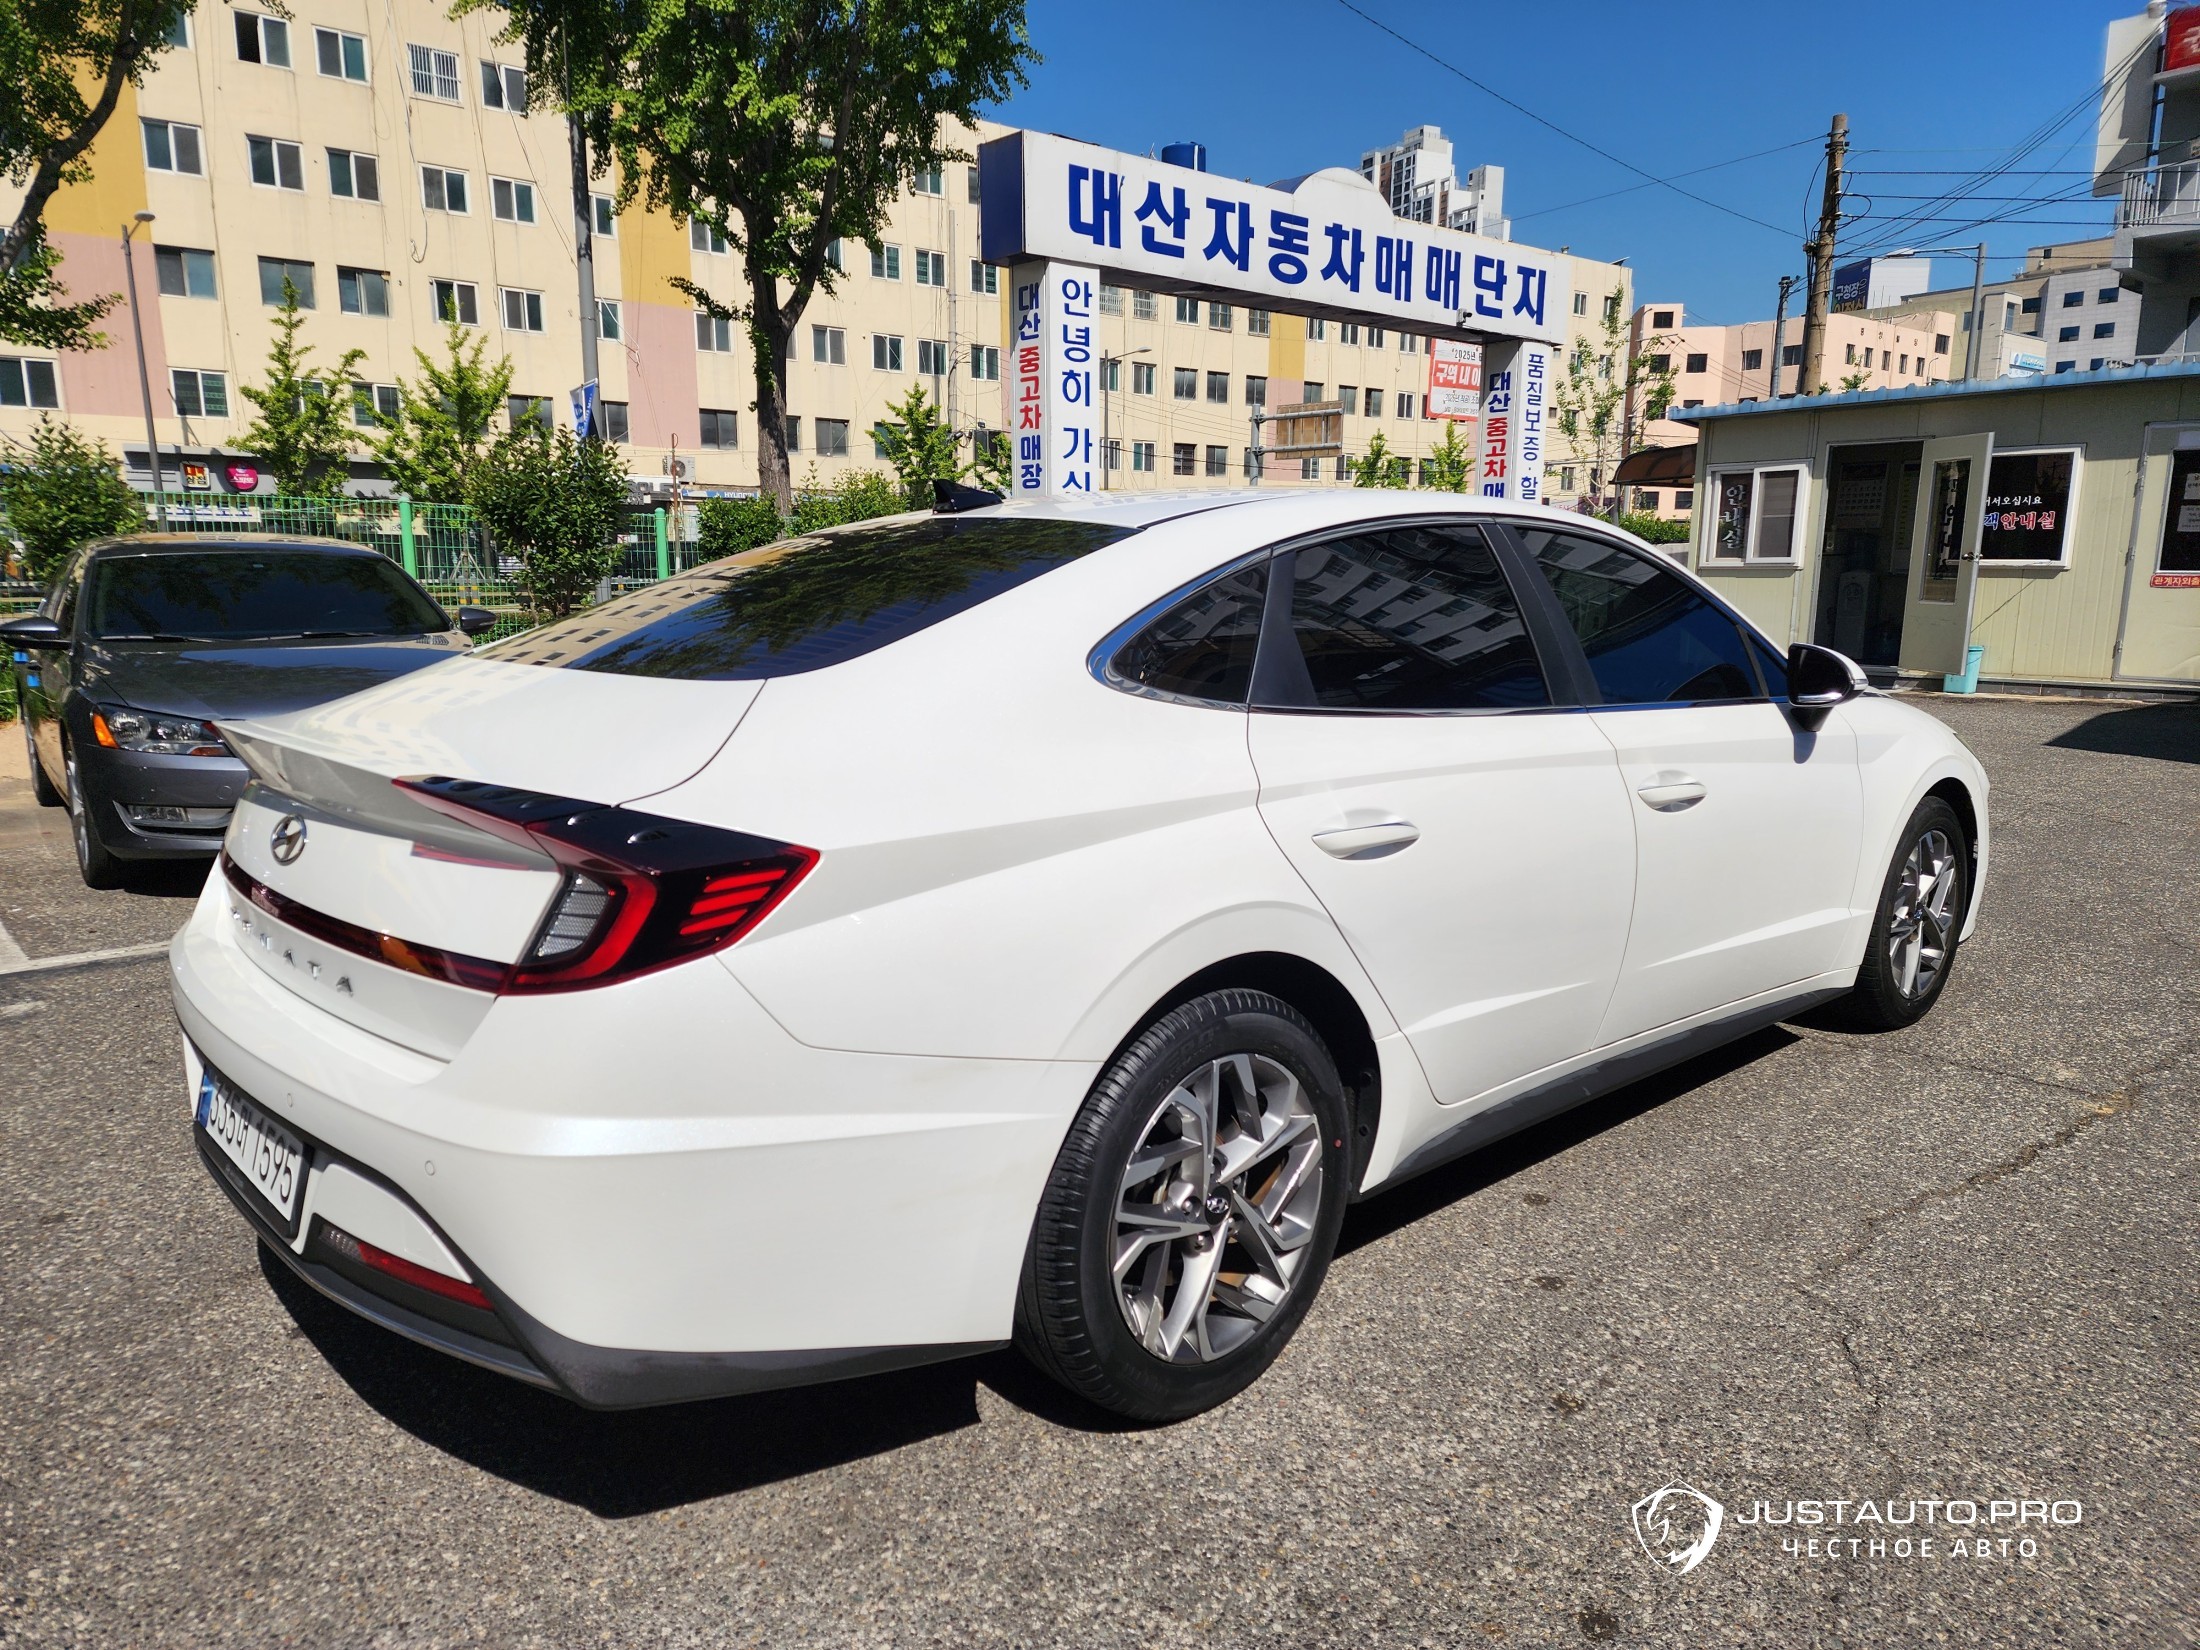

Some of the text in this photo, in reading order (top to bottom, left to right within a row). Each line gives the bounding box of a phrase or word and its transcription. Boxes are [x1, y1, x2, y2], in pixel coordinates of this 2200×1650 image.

[1068, 163, 1547, 326] 대산자동차매매단지
[1018, 282, 1043, 490] 대산 중고차 매장
[1061, 278, 1093, 407] 안녕히
[1488, 371, 1511, 414] 대산
[1483, 417, 1508, 478] 중고차
[1718, 484, 1746, 549] 안내실
[252, 1117, 297, 1204] 1595
